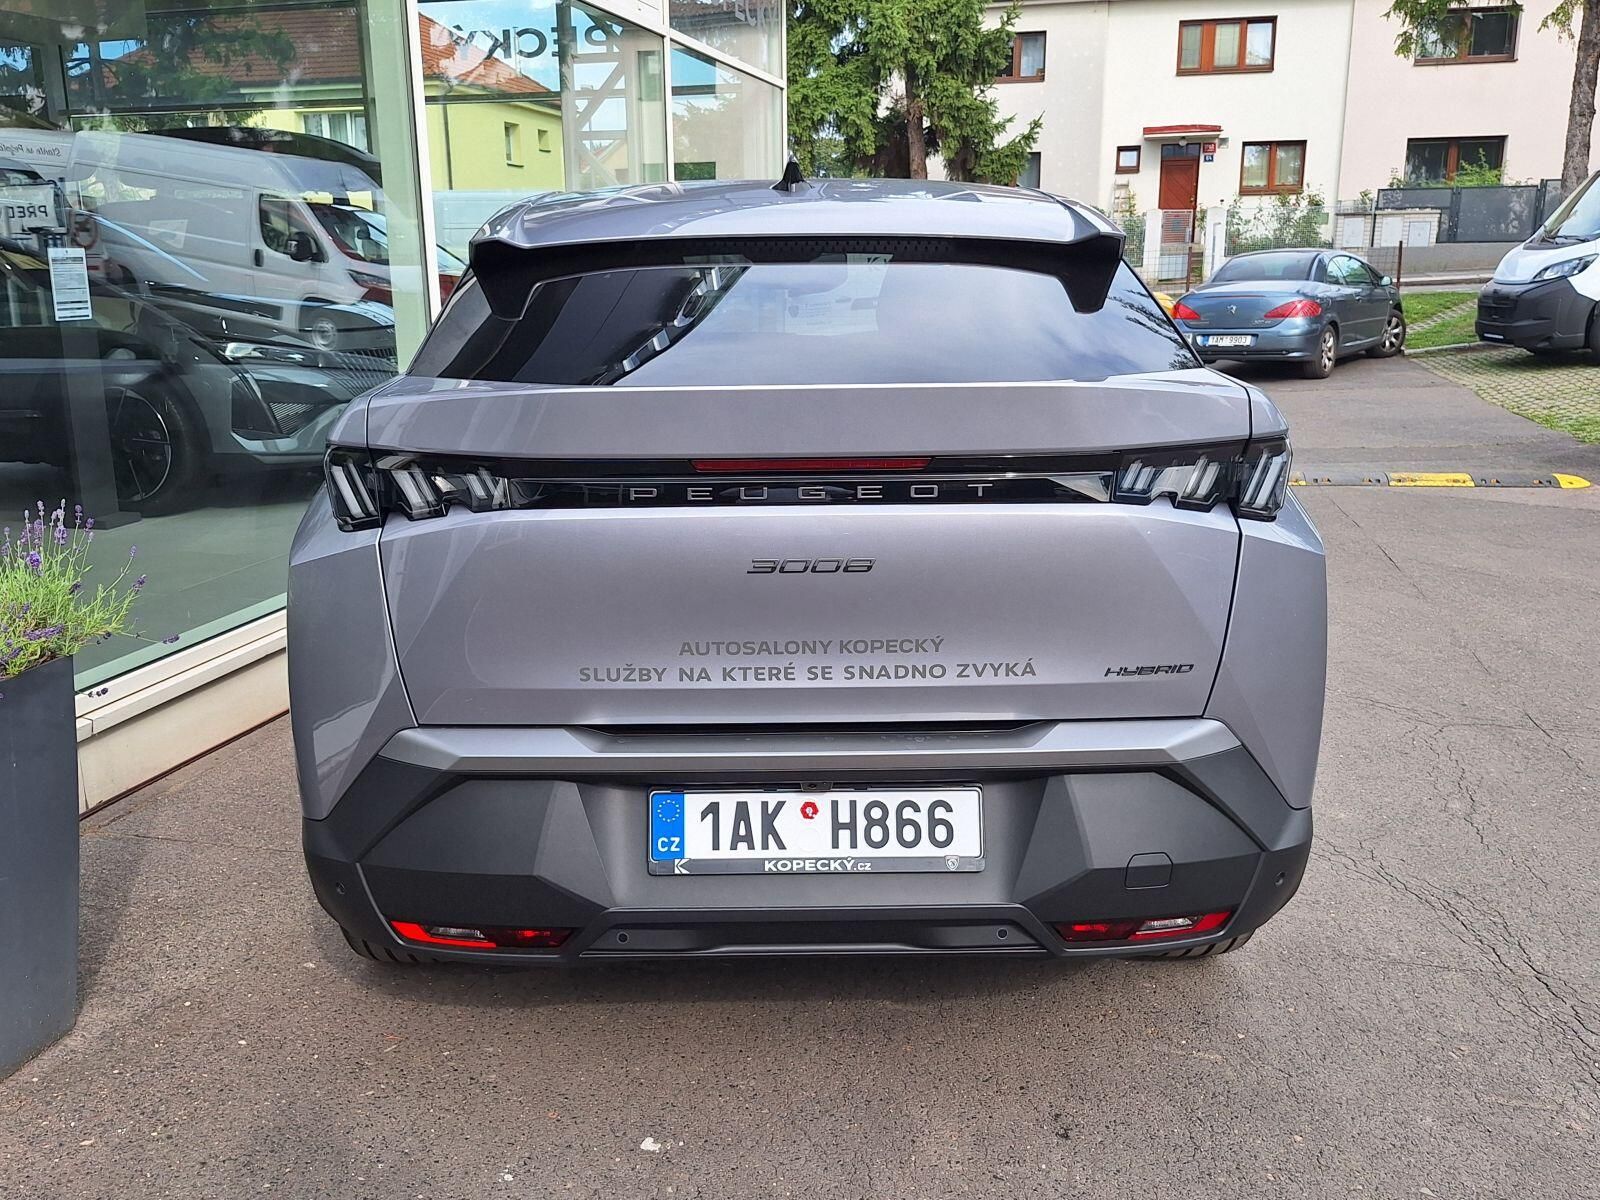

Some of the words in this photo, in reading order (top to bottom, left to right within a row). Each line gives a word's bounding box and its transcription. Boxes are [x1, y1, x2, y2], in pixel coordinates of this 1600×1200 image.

[629, 483, 993, 501] PEUGEOT
[747, 557, 876, 574] 3008
[679, 640, 833, 656] AUTOSALONY
[839, 635, 945, 654] KOPECKÝ
[579, 663, 667, 682] SLUŽBY
[679, 667, 712, 682] NA
[722, 662, 796, 682] KTERÉ
[807, 665, 833, 680] SE
[843, 663, 947, 680] SNADNO
[956, 658, 1037, 678] ZVYKÁ
[1104, 664, 1194, 677] HYBRID
[700, 800, 787, 851] 1AK
[831, 799, 954, 849] H866
[657, 837, 681, 852] CZ
